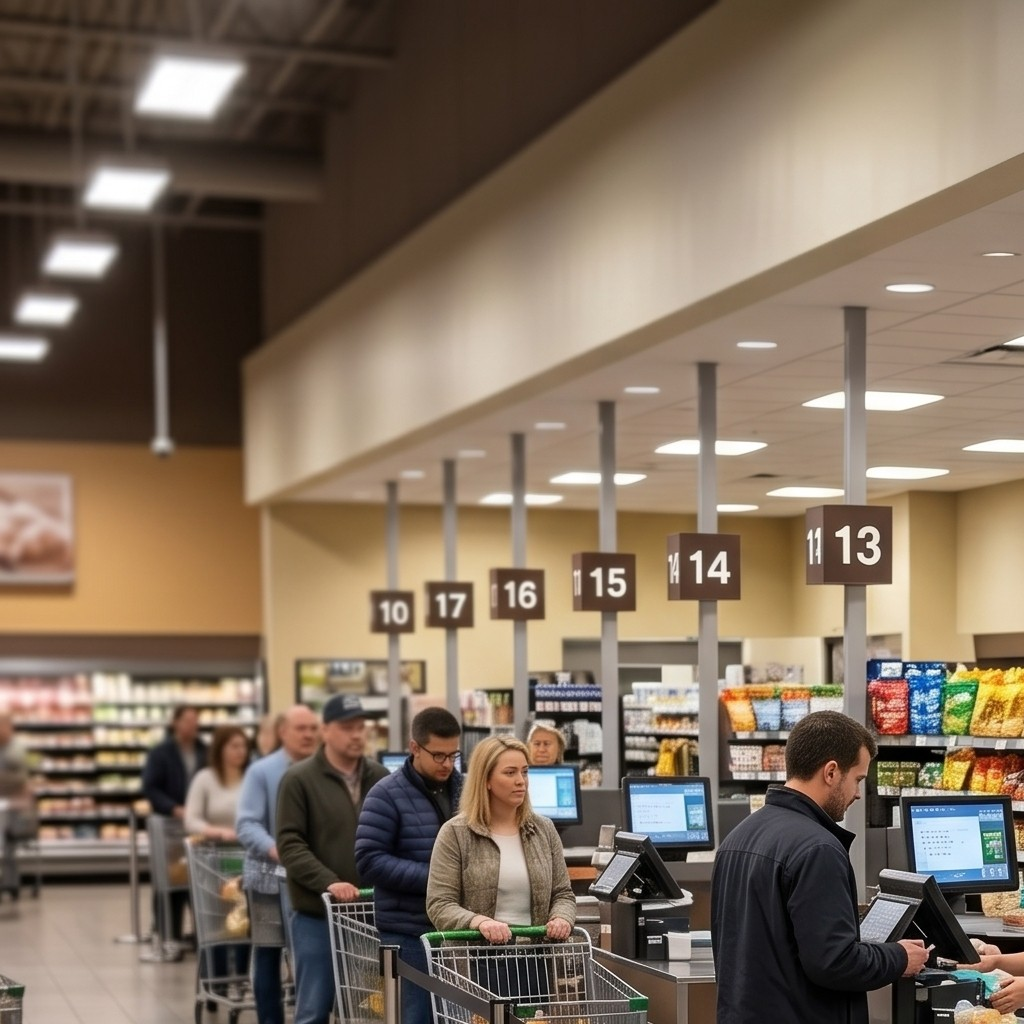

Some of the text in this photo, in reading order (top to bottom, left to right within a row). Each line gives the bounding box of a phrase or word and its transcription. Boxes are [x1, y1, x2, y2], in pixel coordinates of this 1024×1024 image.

[834, 525, 882, 566] 13
[689, 550, 731, 584] 14
[503, 581, 537, 609] 16
[589, 567, 627, 598] 15
[379, 600, 409, 625] 10
[435, 593, 467, 618] 17
